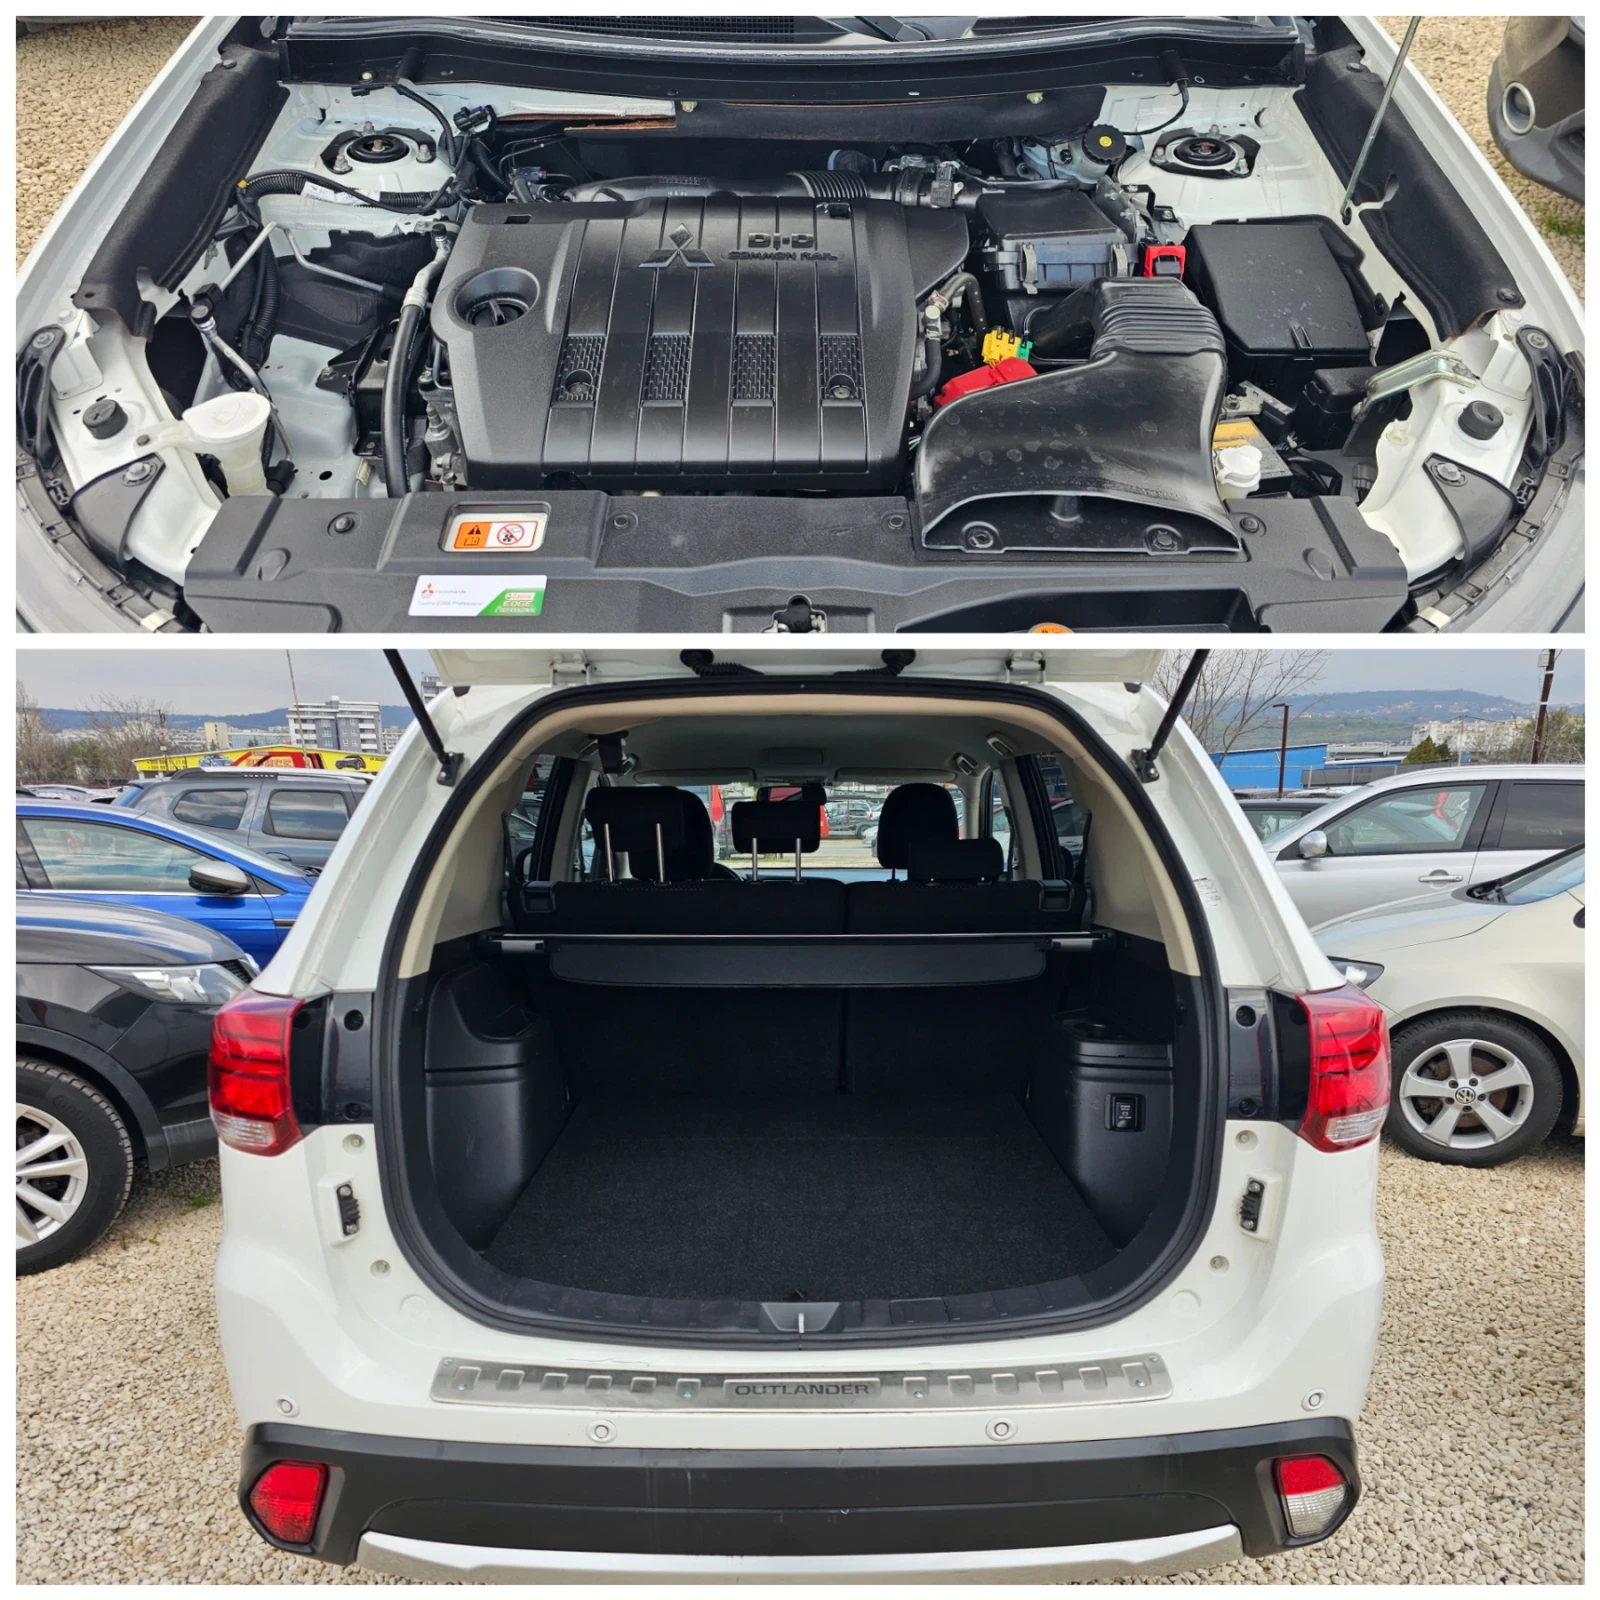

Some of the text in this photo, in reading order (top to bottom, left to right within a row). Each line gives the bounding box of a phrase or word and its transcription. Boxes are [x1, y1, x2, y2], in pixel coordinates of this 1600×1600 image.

[728, 251, 838, 261] COMMON RAIL
[502, 600, 533, 608] EDGE
[734, 1384, 870, 1396] OUTLANDER
